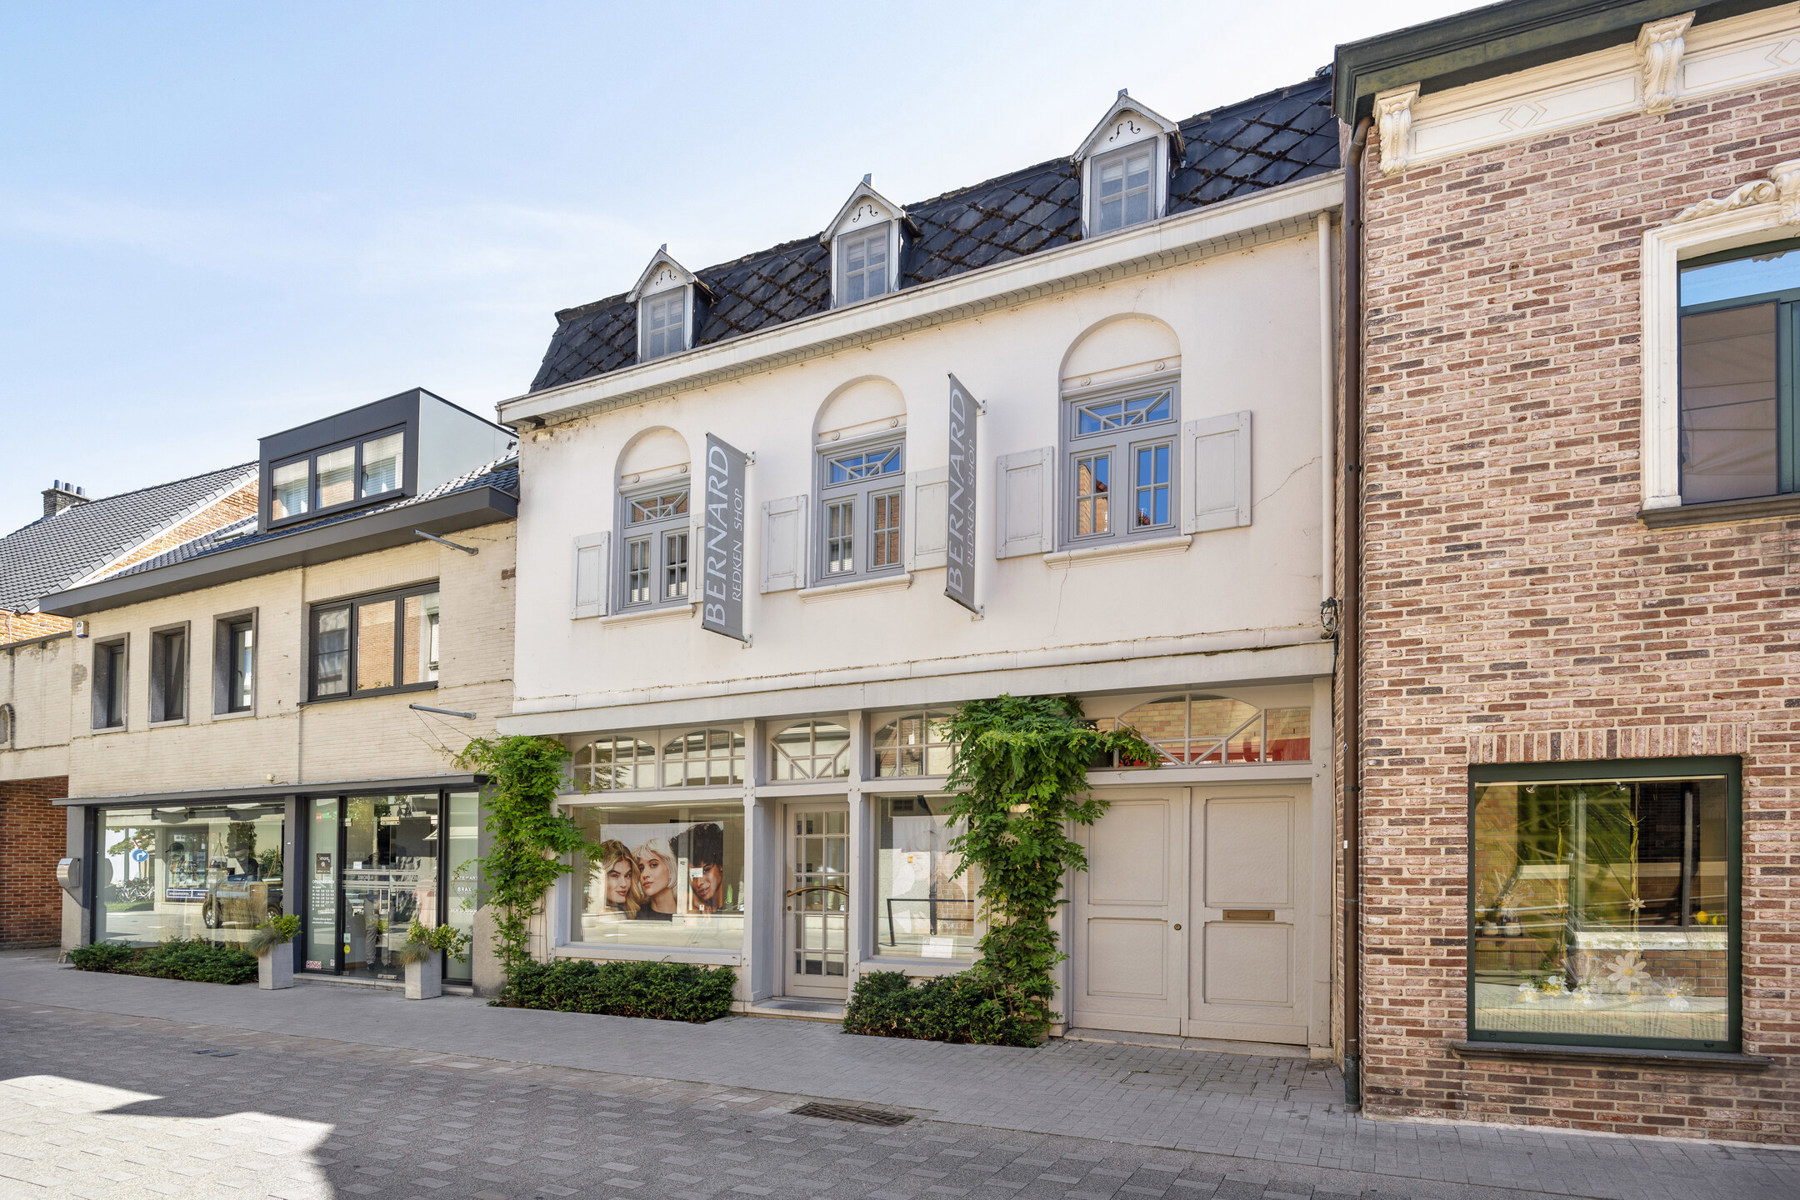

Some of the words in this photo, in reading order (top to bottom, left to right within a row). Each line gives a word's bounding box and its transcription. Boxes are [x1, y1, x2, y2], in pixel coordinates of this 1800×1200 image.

[733, 488, 744, 531] SHOP
[949, 388, 966, 594] BERNARD
[705, 445, 729, 627] BERNARD
[967, 498, 975, 568] REDKEN
[732, 540, 743, 602] REDKEN
